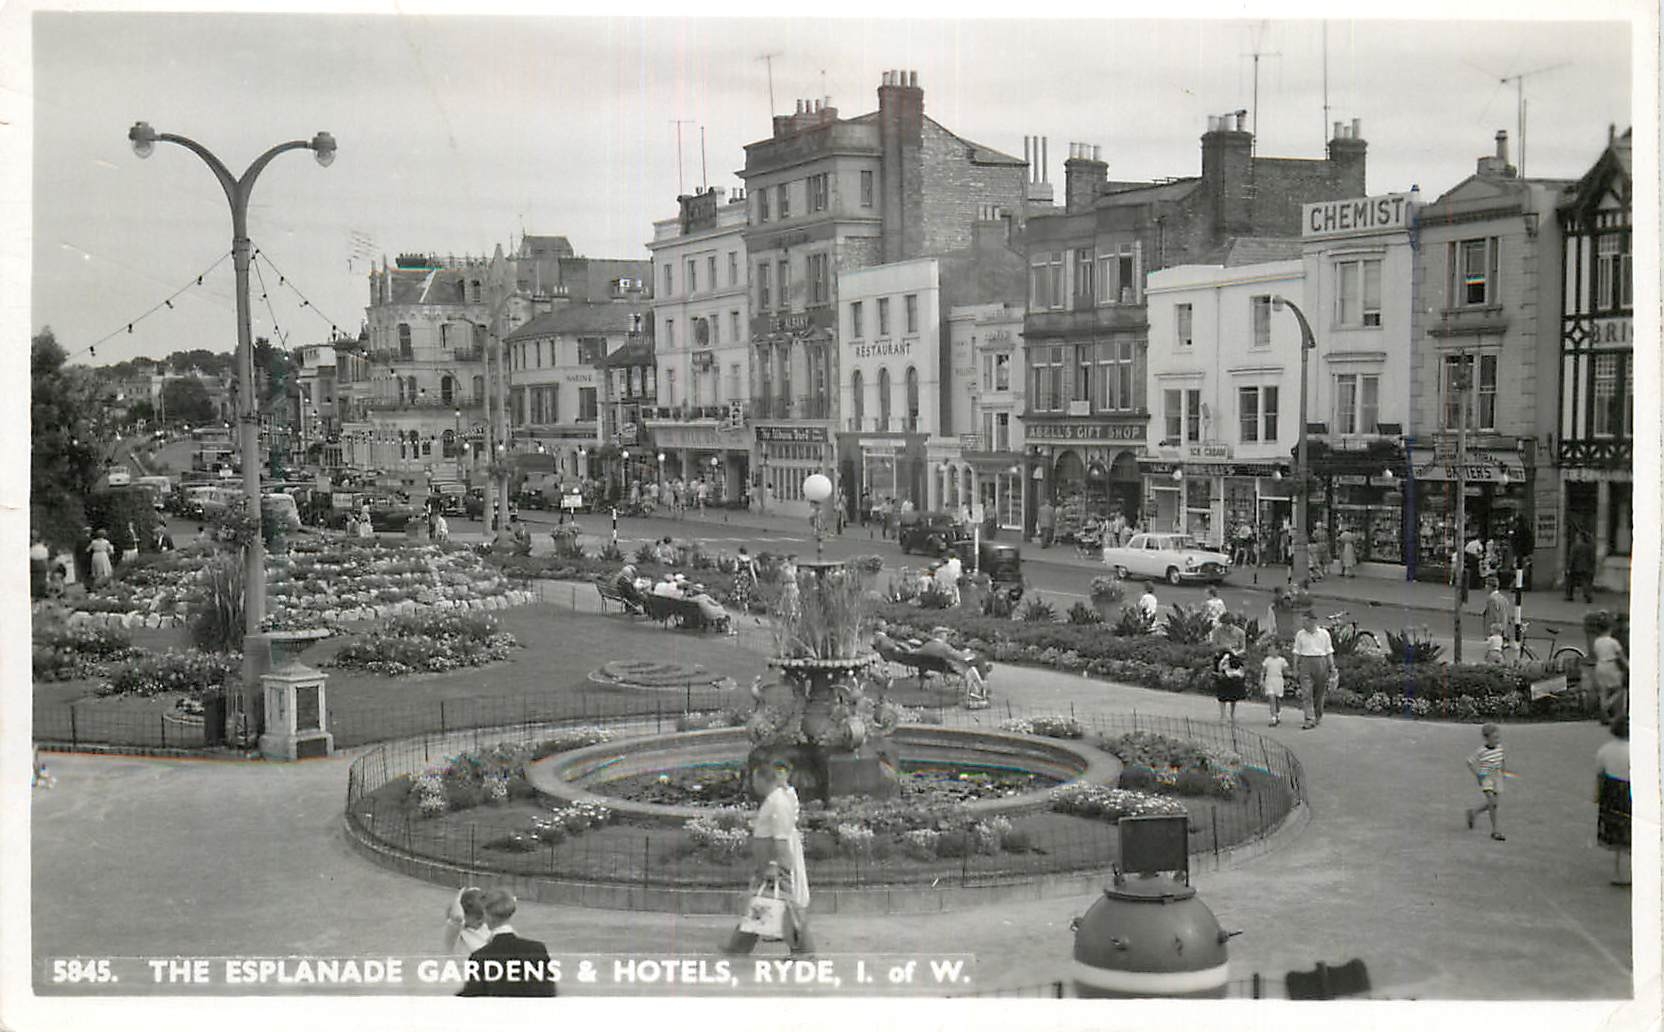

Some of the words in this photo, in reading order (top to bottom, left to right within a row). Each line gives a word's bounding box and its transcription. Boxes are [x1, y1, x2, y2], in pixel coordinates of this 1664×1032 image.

[1310, 197, 1404, 232] CHEMIST
[1592, 321, 1634, 343] BRI
[856, 343, 911, 358] RESTAURANT
[1076, 426, 1102, 439] GIFT
[1108, 425, 1140, 439] SHOP
[1190, 447, 1201, 456] ICE
[1203, 447, 1227, 456] CREAM
